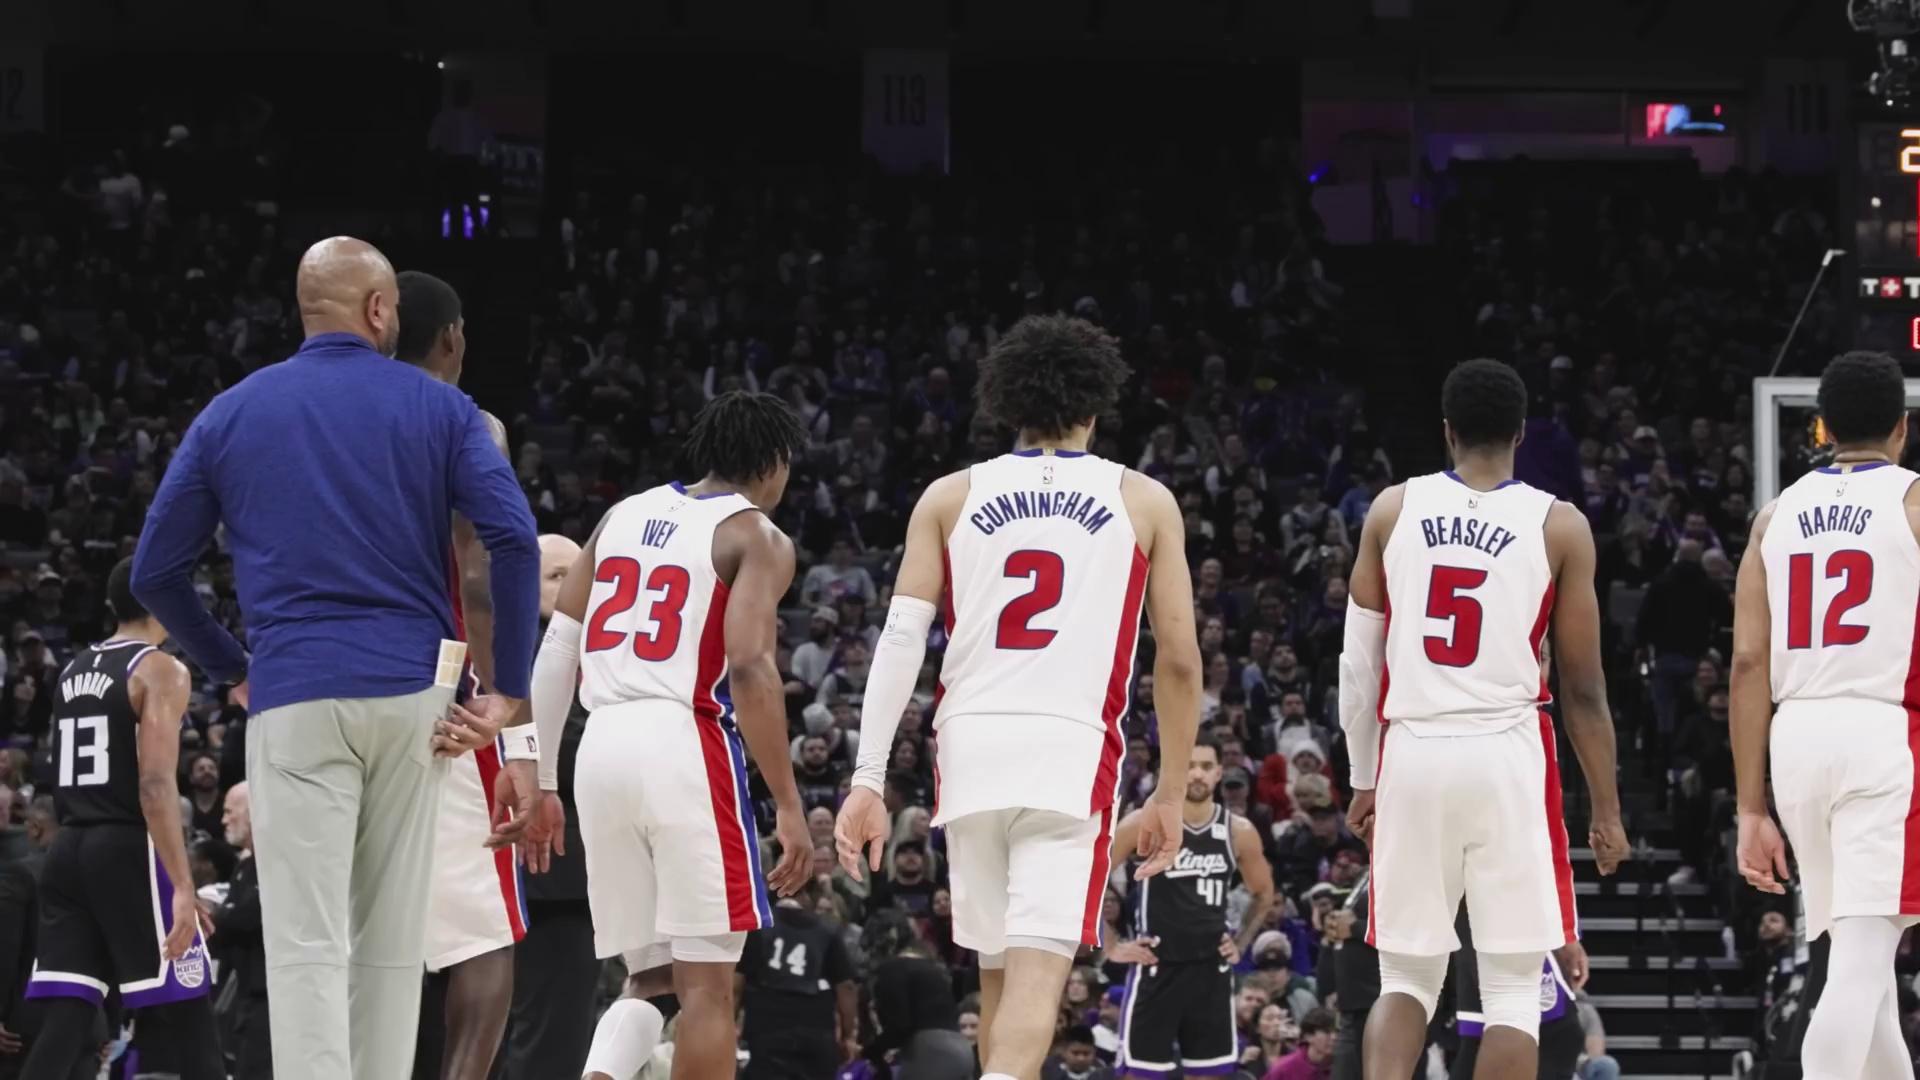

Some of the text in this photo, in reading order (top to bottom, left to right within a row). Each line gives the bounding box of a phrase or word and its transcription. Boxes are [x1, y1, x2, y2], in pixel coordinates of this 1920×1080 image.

[882, 73, 927, 126] 113
[641, 518, 679, 549] IVEY
[970, 491, 1114, 536] CUNNINGHAM
[1797, 504, 1873, 539] HARRIS
[1420, 516, 1517, 558] BEASLEY
[585, 555, 691, 662] 23
[995, 549, 1065, 650] 2
[1423, 564, 1489, 668] 5
[1787, 548, 1874, 650] 12
[61, 671, 114, 703] MURRAY
[58, 715, 109, 787] 13
[1197, 879, 1223, 906] 41
[768, 937, 806, 976] 14
